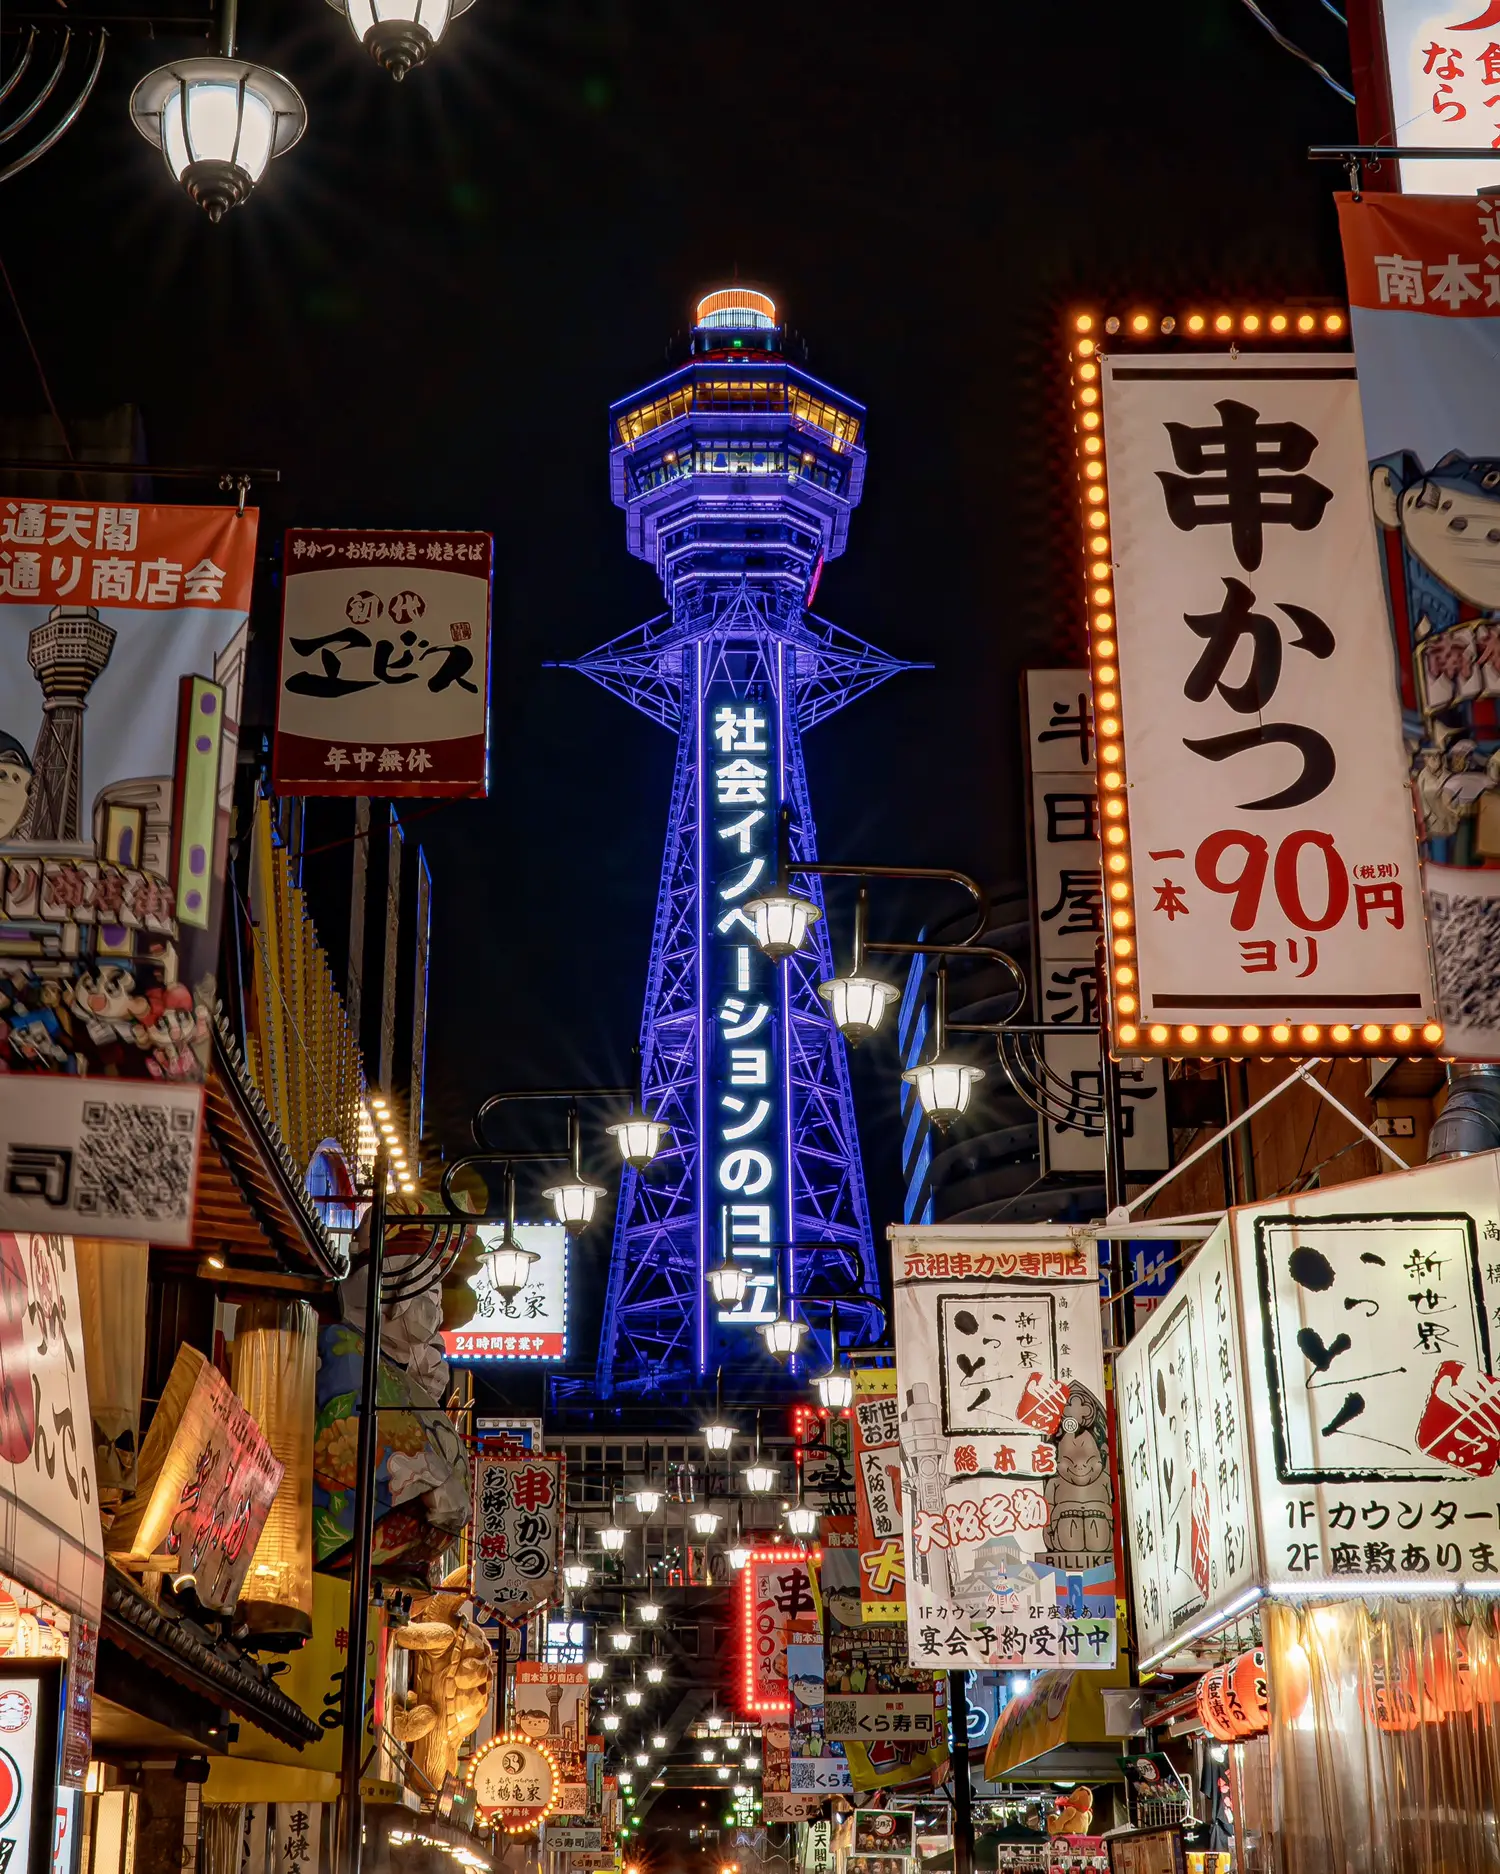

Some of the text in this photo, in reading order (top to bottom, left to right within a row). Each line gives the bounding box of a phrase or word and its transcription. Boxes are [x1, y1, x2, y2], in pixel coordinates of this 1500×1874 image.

[1422, 41, 1467, 122] なら
[0, 502, 140, 552] 通天閣
[0, 551, 227, 603] 通り商店会
[346, 591, 425, 624] 初代
[1154, 398, 1335, 811] 串かつ
[324, 747, 433, 773] 年中無休
[1239, 936, 1318, 978] ヨリ
[903, 1252, 1088, 1277] 元祖串カツ専門店
[1402, 1248, 1460, 1355] 新世界
[455, 1336, 545, 1351] 24時間営業中
[1015, 1311, 1042, 1368] 新世界
[953, 1445, 1056, 1472] 総本店
[865, 1454, 893, 1534] 大阪名物
[479, 1466, 510, 1580] お好み焼き
[511, 1465, 555, 1579] 串かつ
[913, 1489, 1050, 1555] 大阪名物
[774, 1568, 817, 1620] 串
[917, 1625, 1111, 1657] 宴会予約受付中
[521, 1672, 585, 1683] 南本通り商店会
[539, 1663, 567, 1673] 通天閣
[1207, 1668, 1231, 1729] 二度漬け
[857, 1713, 933, 1733] くら寿司
[498, 1783, 542, 1802] 鶴亀家
[546, 1837, 585, 1848] くら寿司
